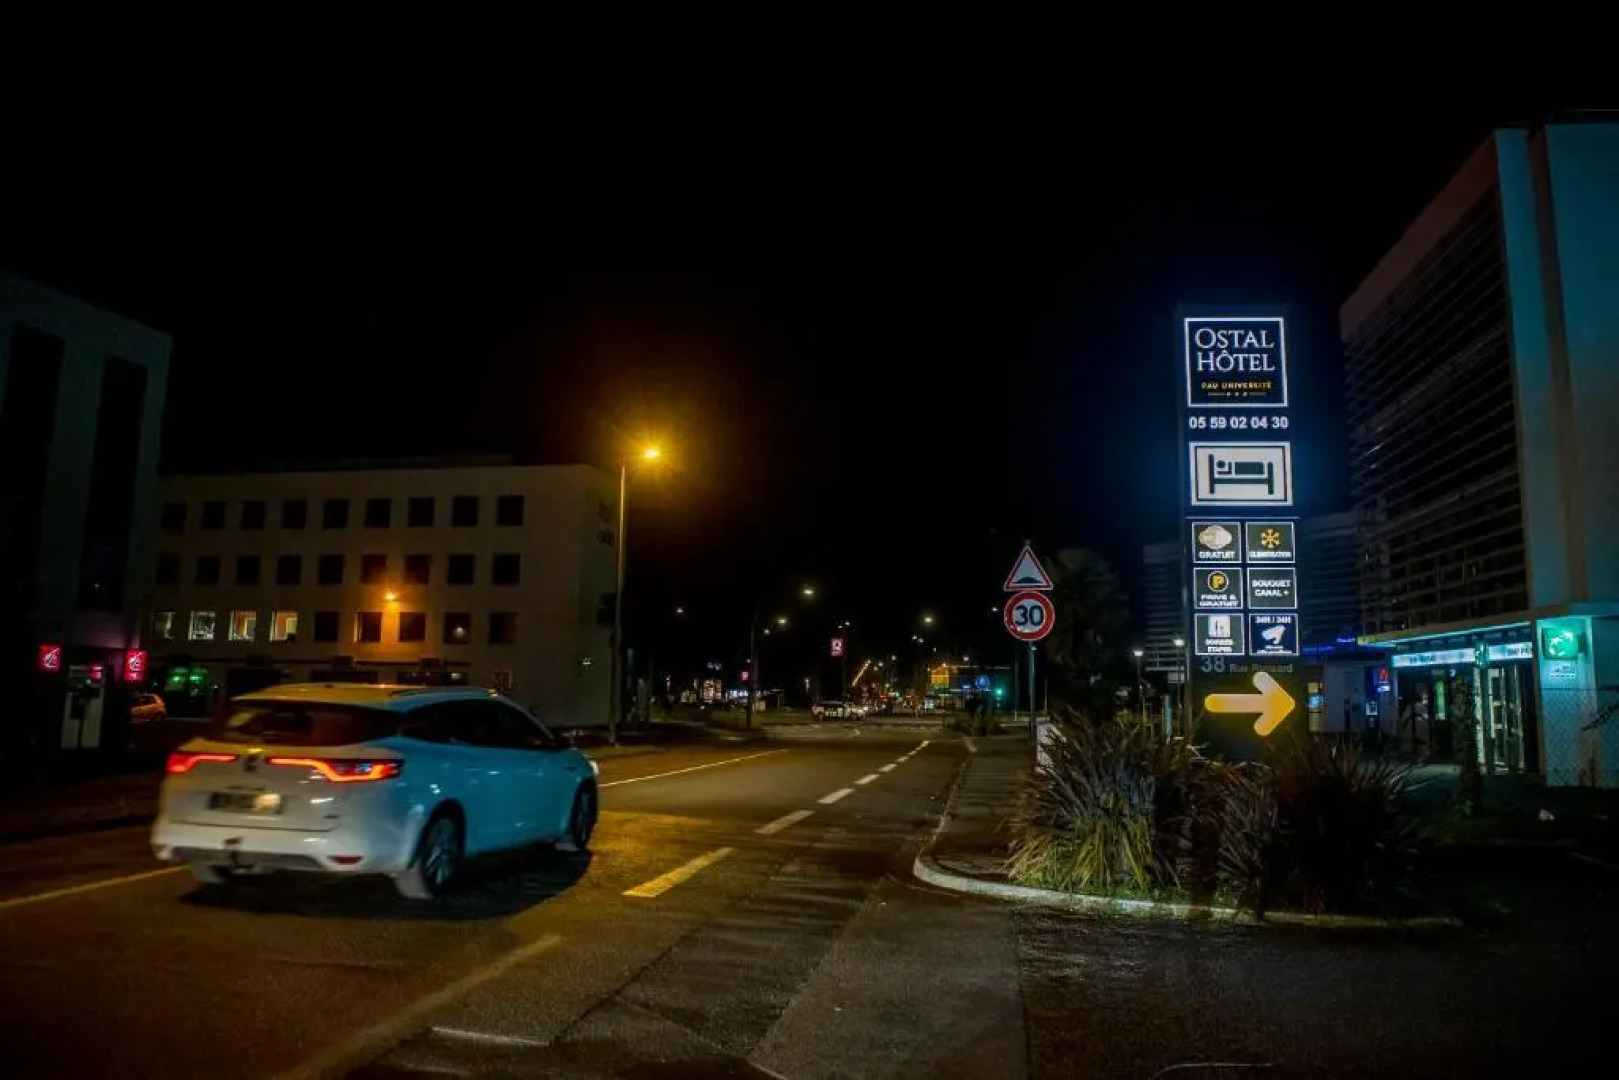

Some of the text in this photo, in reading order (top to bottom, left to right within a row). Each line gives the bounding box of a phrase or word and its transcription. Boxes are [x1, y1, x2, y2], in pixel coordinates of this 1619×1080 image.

[1195, 328, 1275, 349] OSTAL
[1197, 349, 1275, 372] HÔTEL
[1201, 382, 1218, 390] PAU
[1188, 416, 1290, 429] 05 59 02 04 30
[1198, 551, 1235, 559] GRATUIT
[1251, 579, 1291, 588] BOUQUET
[1014, 604, 1044, 627] 30
[1201, 655, 1225, 673] 38
